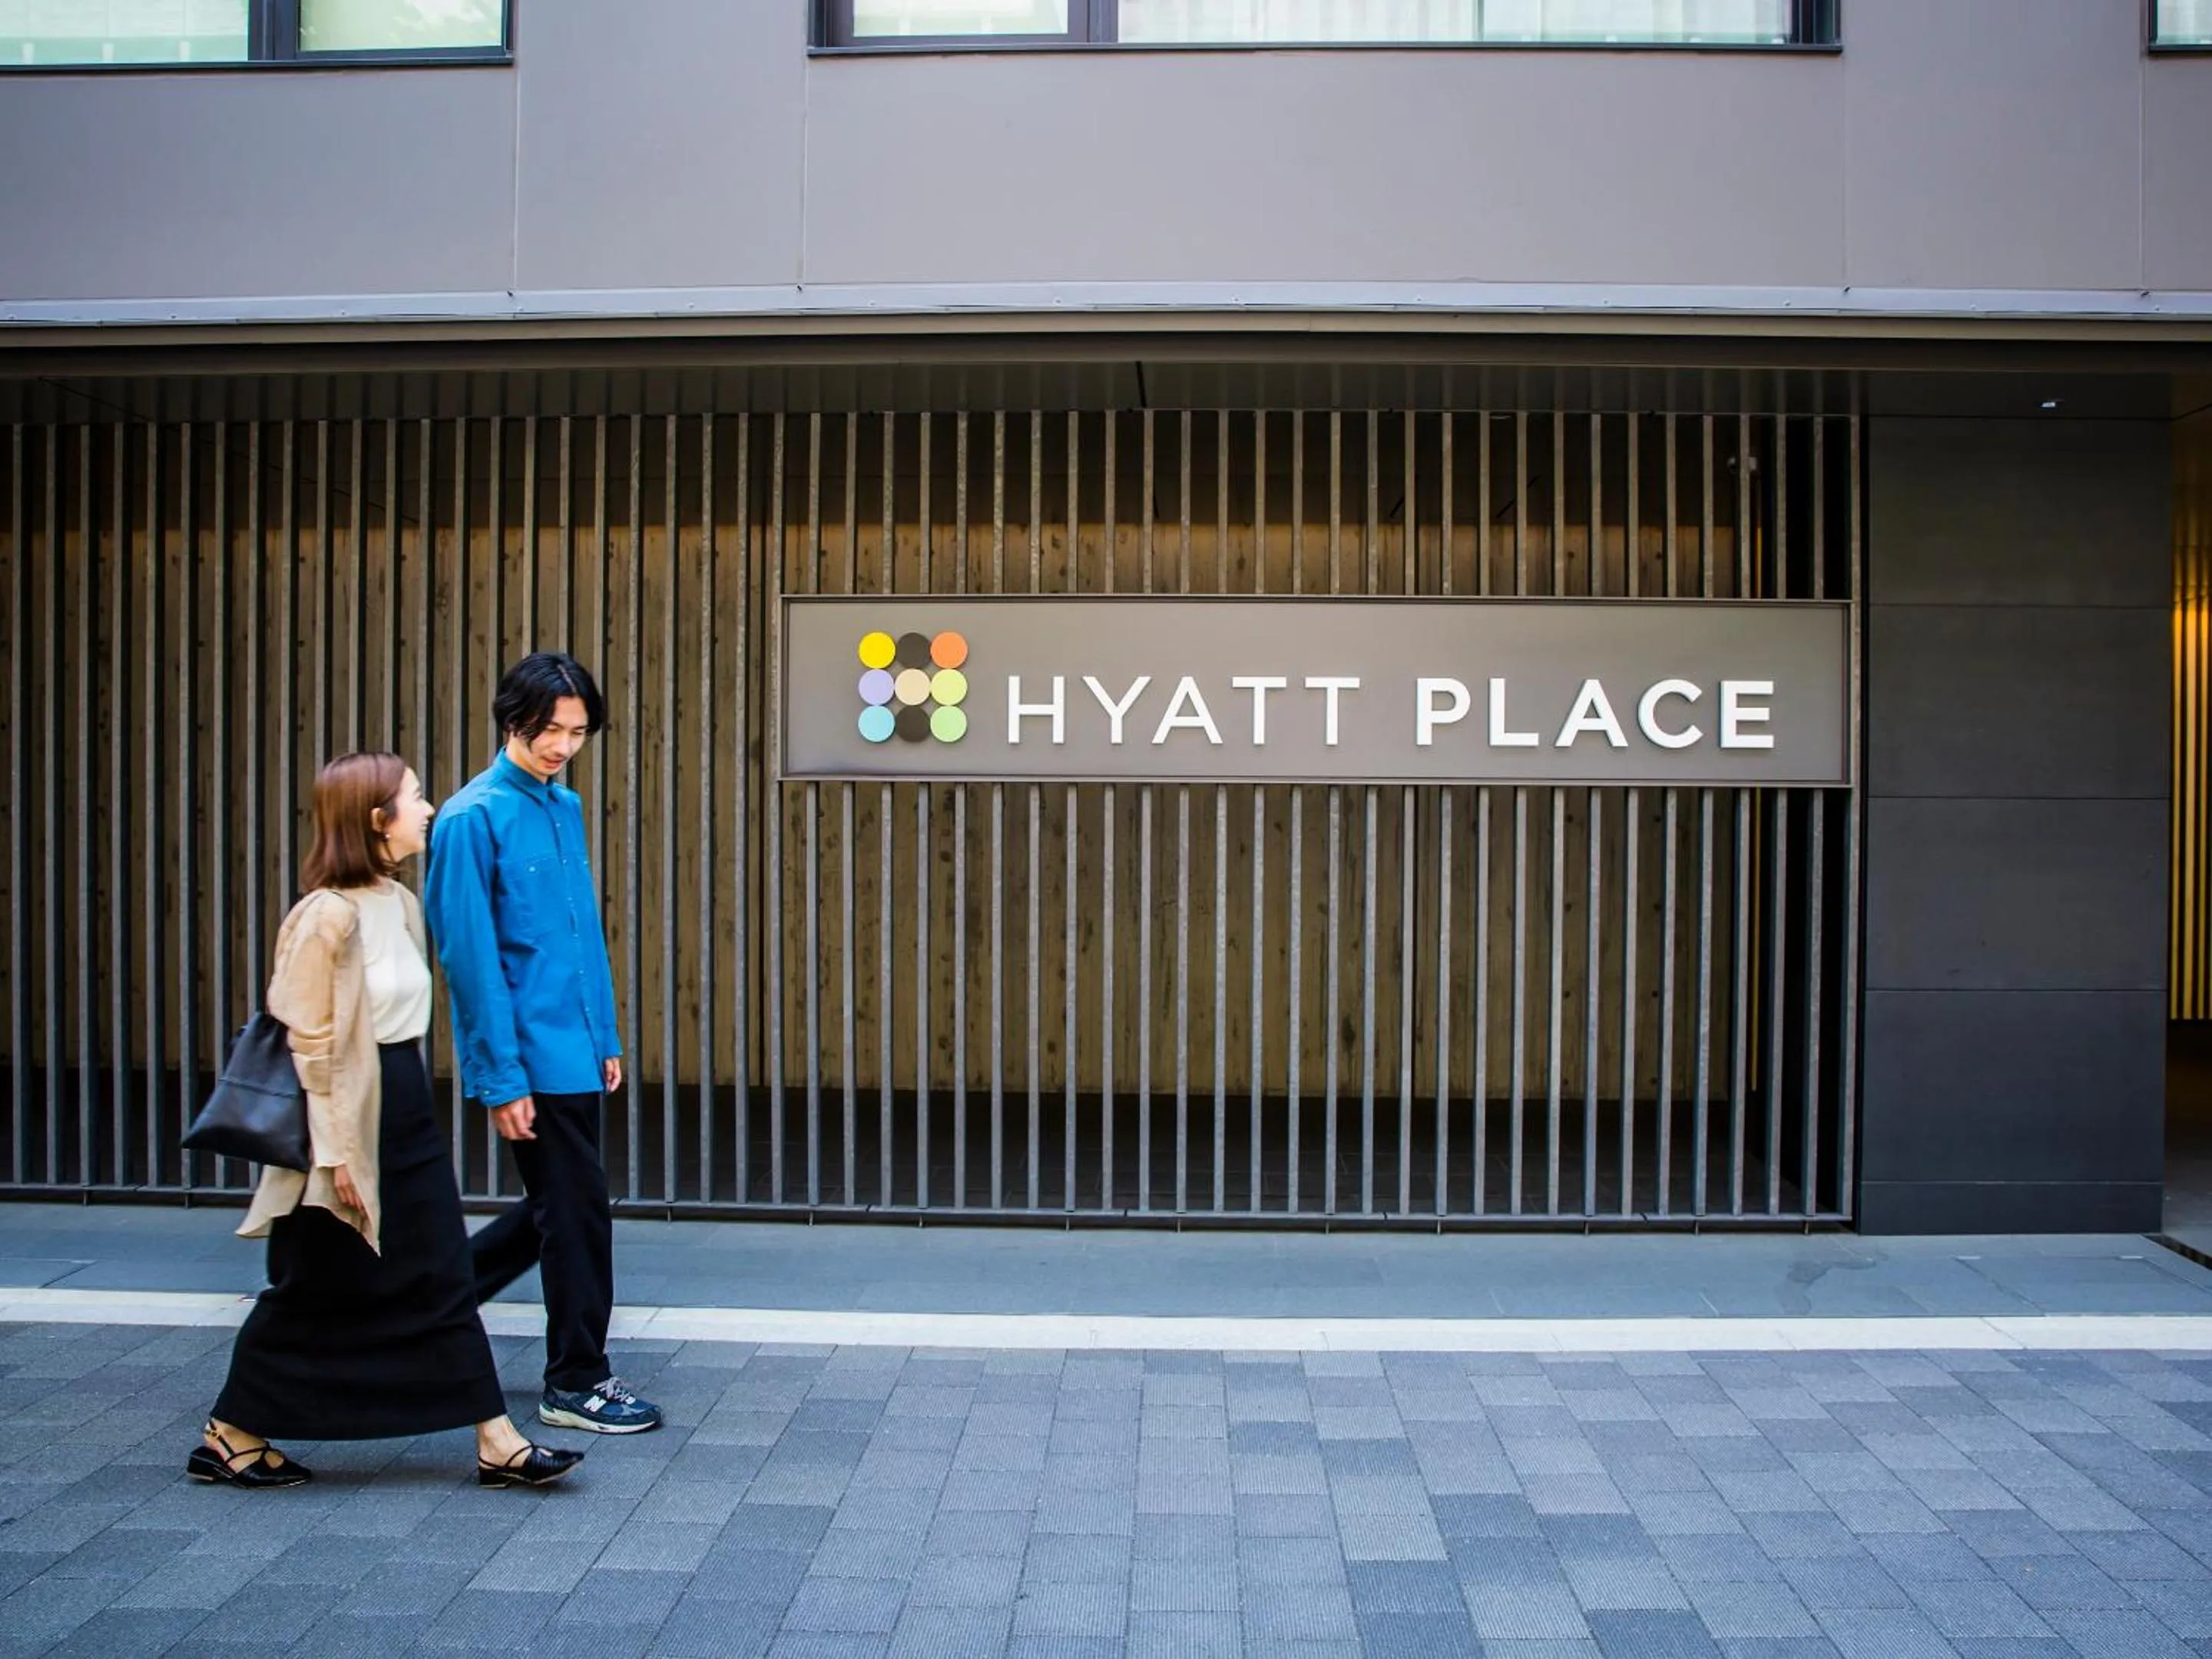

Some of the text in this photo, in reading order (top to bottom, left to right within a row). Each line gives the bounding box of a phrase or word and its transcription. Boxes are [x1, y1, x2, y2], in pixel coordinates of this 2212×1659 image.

[1007, 675, 1775, 749] HYATT PLACE
[584, 1395, 607, 1412] N
